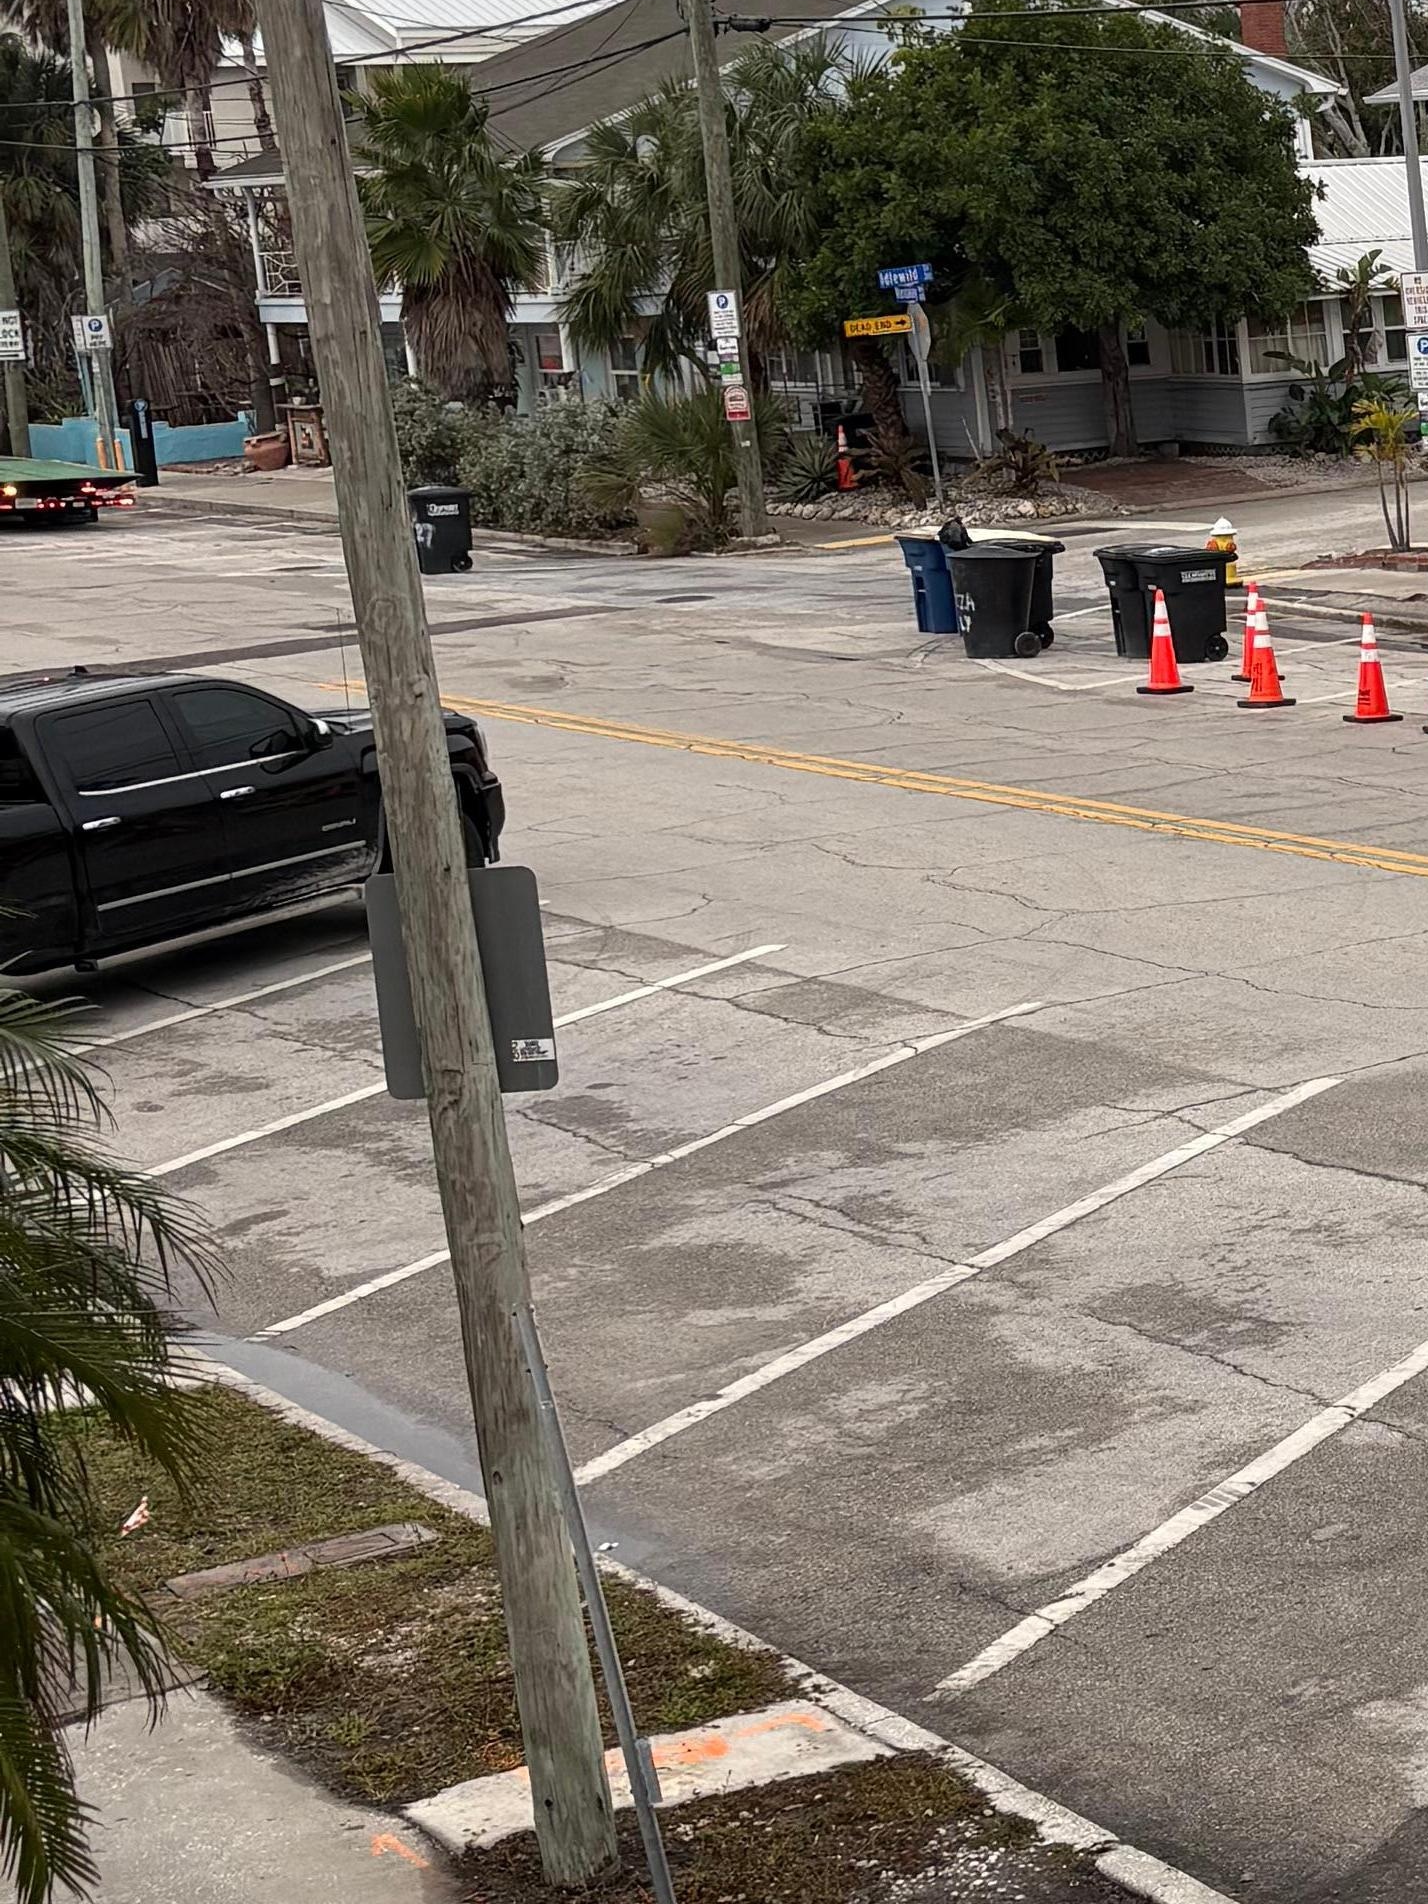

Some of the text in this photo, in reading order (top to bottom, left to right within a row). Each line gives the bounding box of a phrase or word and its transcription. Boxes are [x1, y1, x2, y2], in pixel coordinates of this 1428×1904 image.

[879, 269, 919, 288] Idlewild
[850, 320, 892, 333] DEAD END
